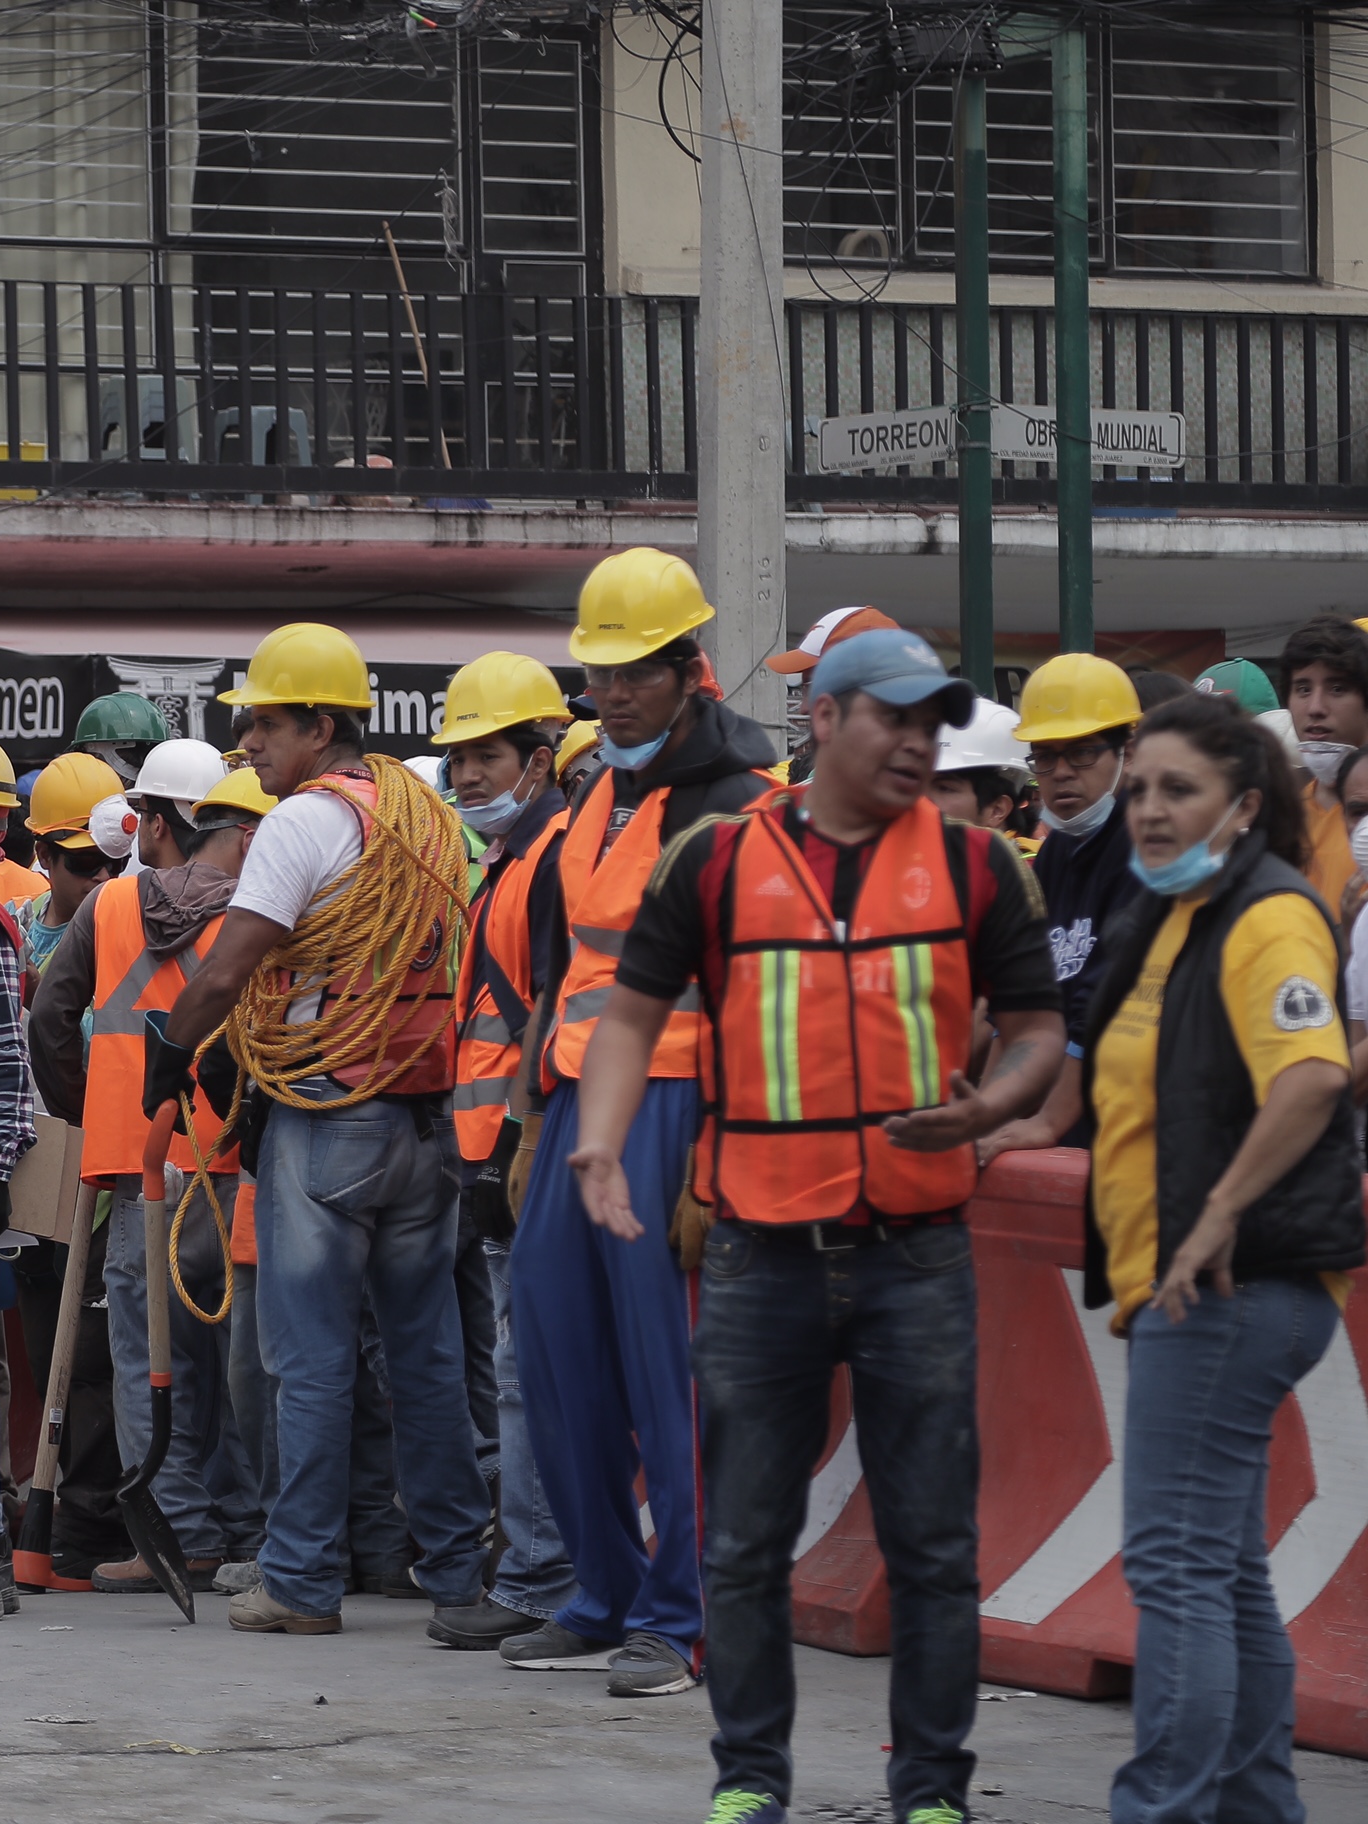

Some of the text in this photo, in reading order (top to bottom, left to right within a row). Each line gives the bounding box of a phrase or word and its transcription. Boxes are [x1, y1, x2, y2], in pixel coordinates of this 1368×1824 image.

[847, 418, 948, 455] TORREON
[1097, 422, 1167, 453] MUNDIAL
[456, 712, 480, 722] PRETUL
